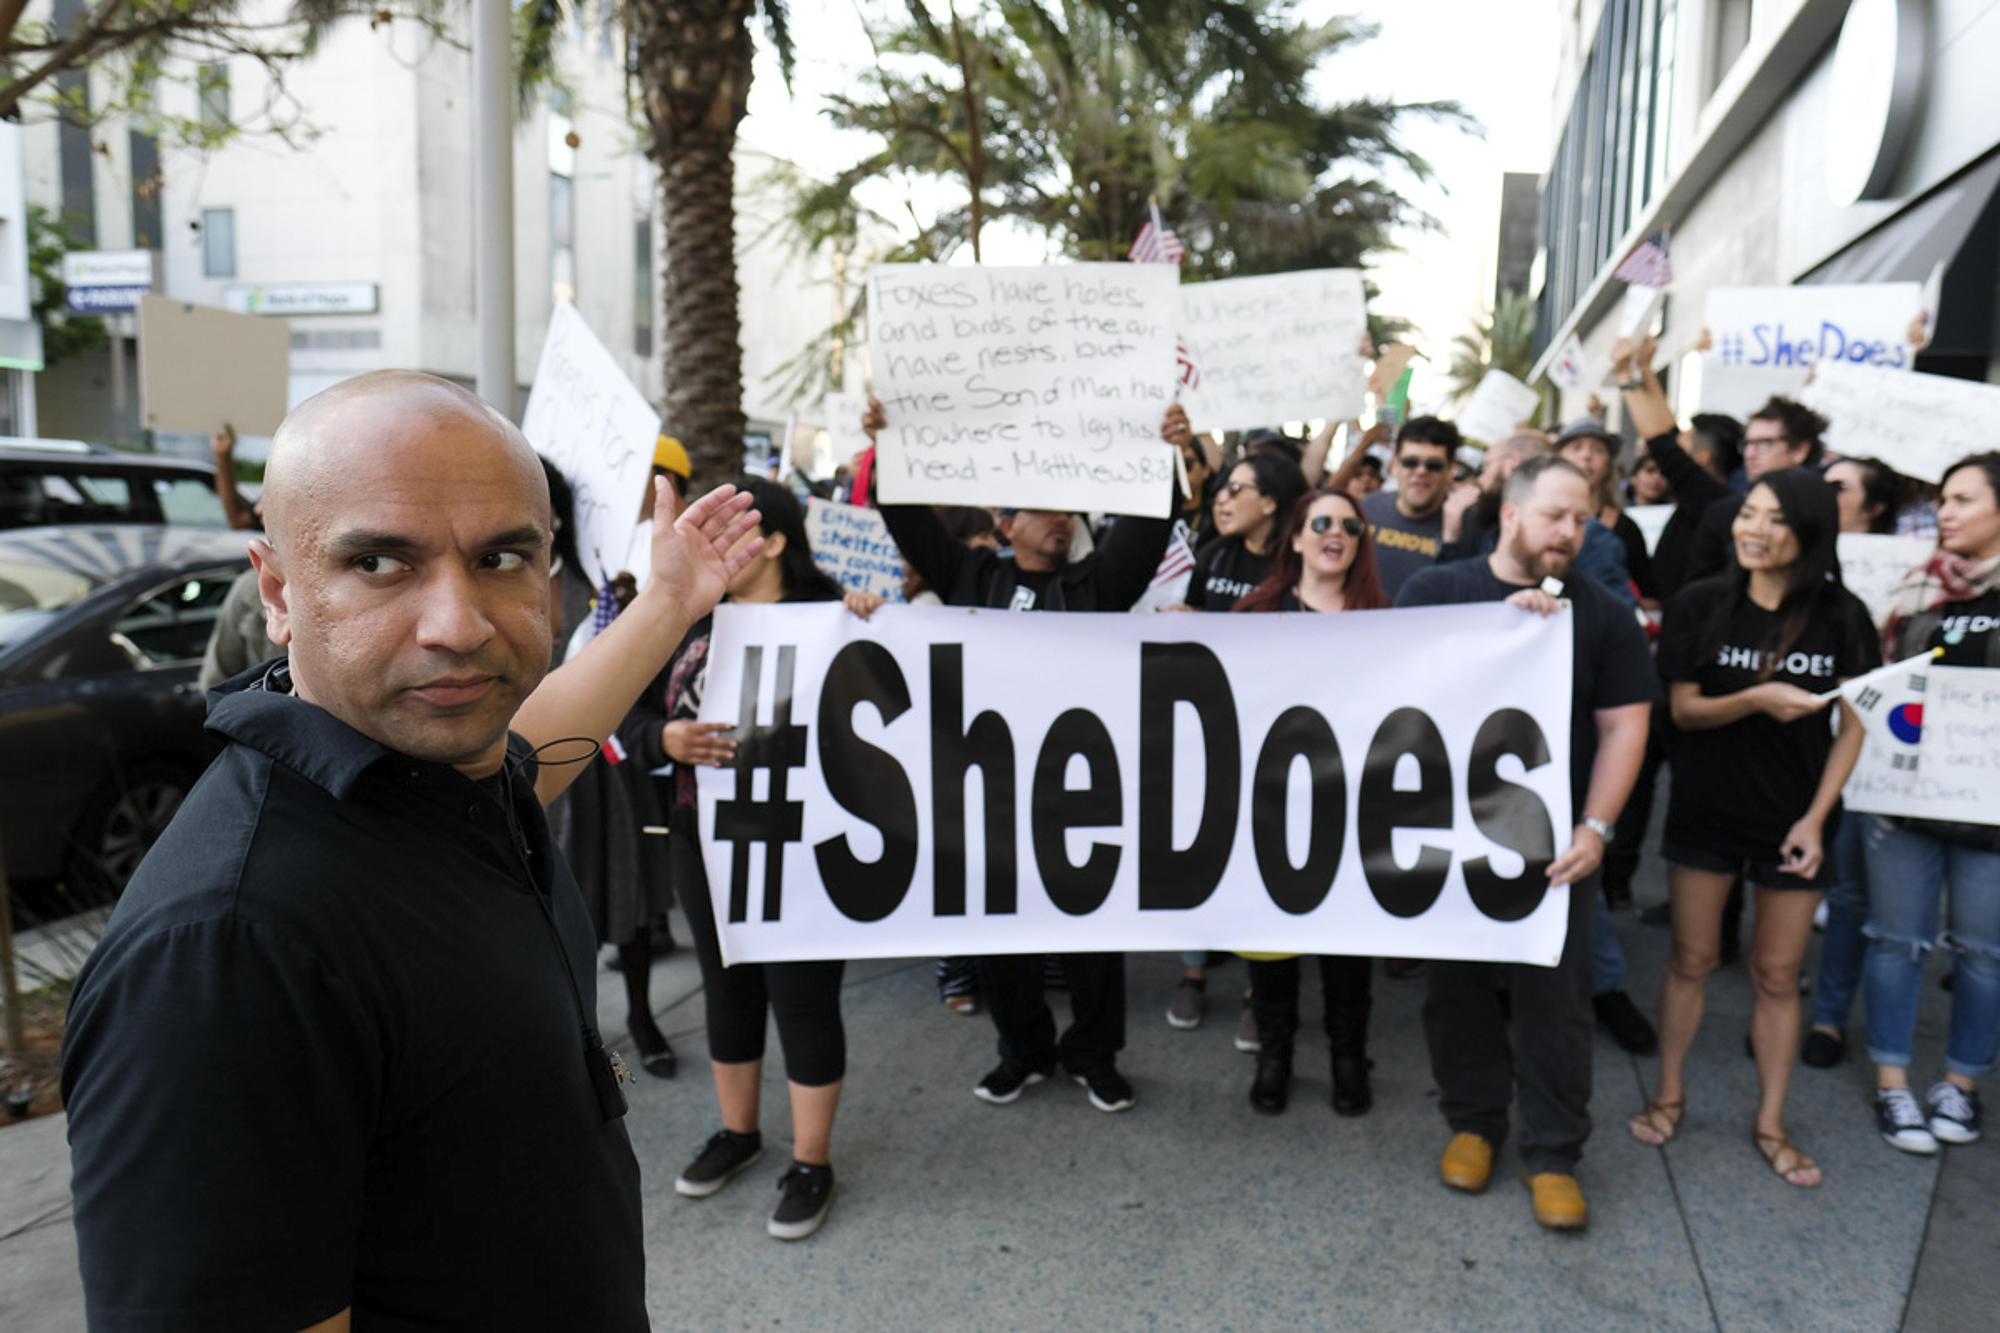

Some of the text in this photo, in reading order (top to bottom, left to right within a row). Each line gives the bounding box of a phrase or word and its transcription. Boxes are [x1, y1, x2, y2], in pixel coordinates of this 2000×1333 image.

[874, 273, 1144, 312] Foxes have holes
[879, 307, 1162, 343] and birds of the air
[1721, 321, 1905, 369] #SheDoes
[886, 349, 967, 380] have
[1075, 340, 1137, 359] but
[886, 373, 1166, 415] the Son of Man has
[900, 412, 1155, 453] nowhere to lay his
[905, 452, 979, 482] head
[1012, 449, 1139, 484] Matthew
[713, 638, 1556, 924] #SheDoes
